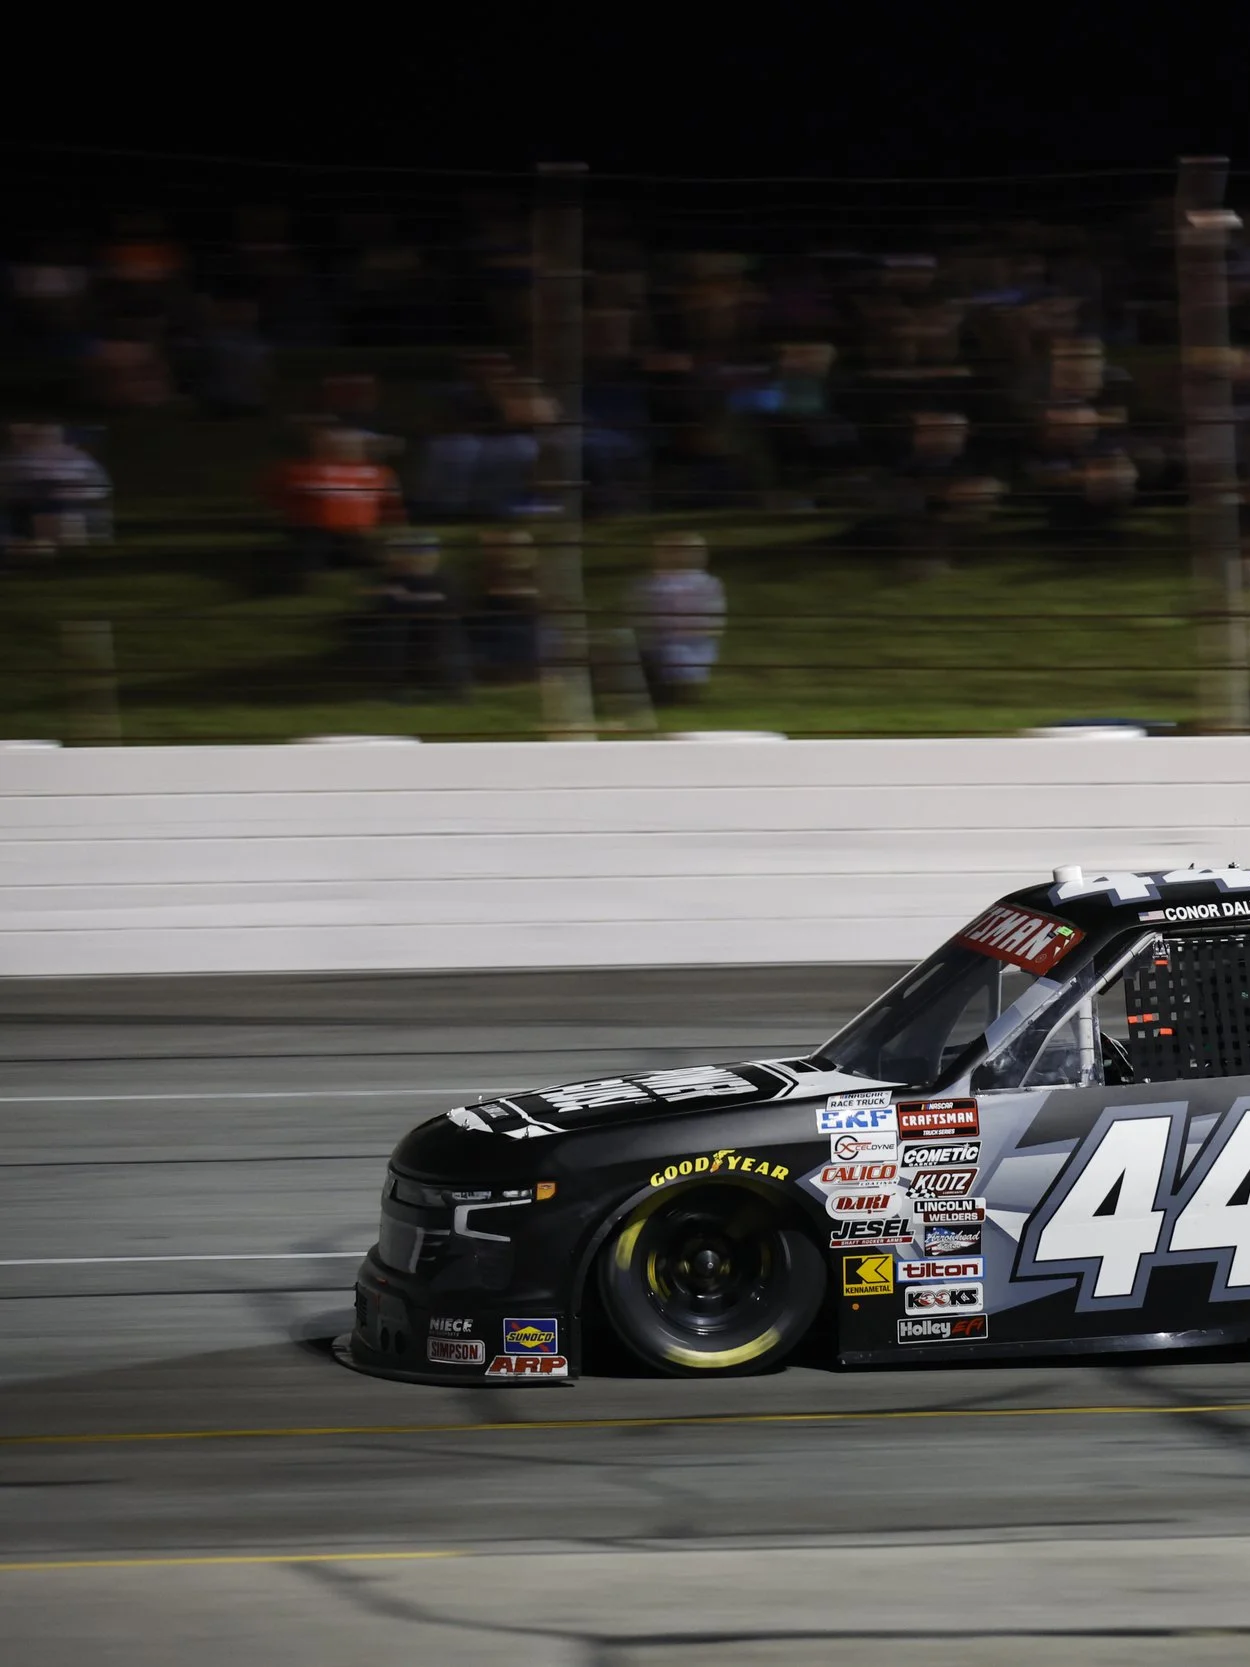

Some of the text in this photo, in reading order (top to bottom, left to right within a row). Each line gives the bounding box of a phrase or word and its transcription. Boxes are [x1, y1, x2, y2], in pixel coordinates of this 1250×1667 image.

[1164, 904, 1219, 922] CONOR
[857, 1098, 886, 1106] TRUCK
[929, 1102, 953, 1110] NASCAR
[821, 1109, 893, 1130] SKF
[902, 1112, 973, 1126] CRAFTSMAN
[903, 1143, 979, 1164] COMETIC
[650, 1153, 791, 1188] GOODYEAR
[821, 1164, 897, 1183] CALICO
[914, 1172, 972, 1191] KLOTZ
[917, 1200, 973, 1212] LINCOLN
[929, 1212, 978, 1222] WELDERS
[832, 1219, 914, 1240] JESEL
[903, 1262, 978, 1278] tilton
[845, 1285, 891, 1294] KENNAMETAL
[907, 1289, 978, 1308] KOOKS
[429, 1318, 474, 1333] NIECE
[900, 1320, 951, 1338] Holley
[507, 1332, 554, 1342] SUNOCO
[431, 1341, 478, 1360] SIMPSON
[488, 1356, 567, 1374] ARP
